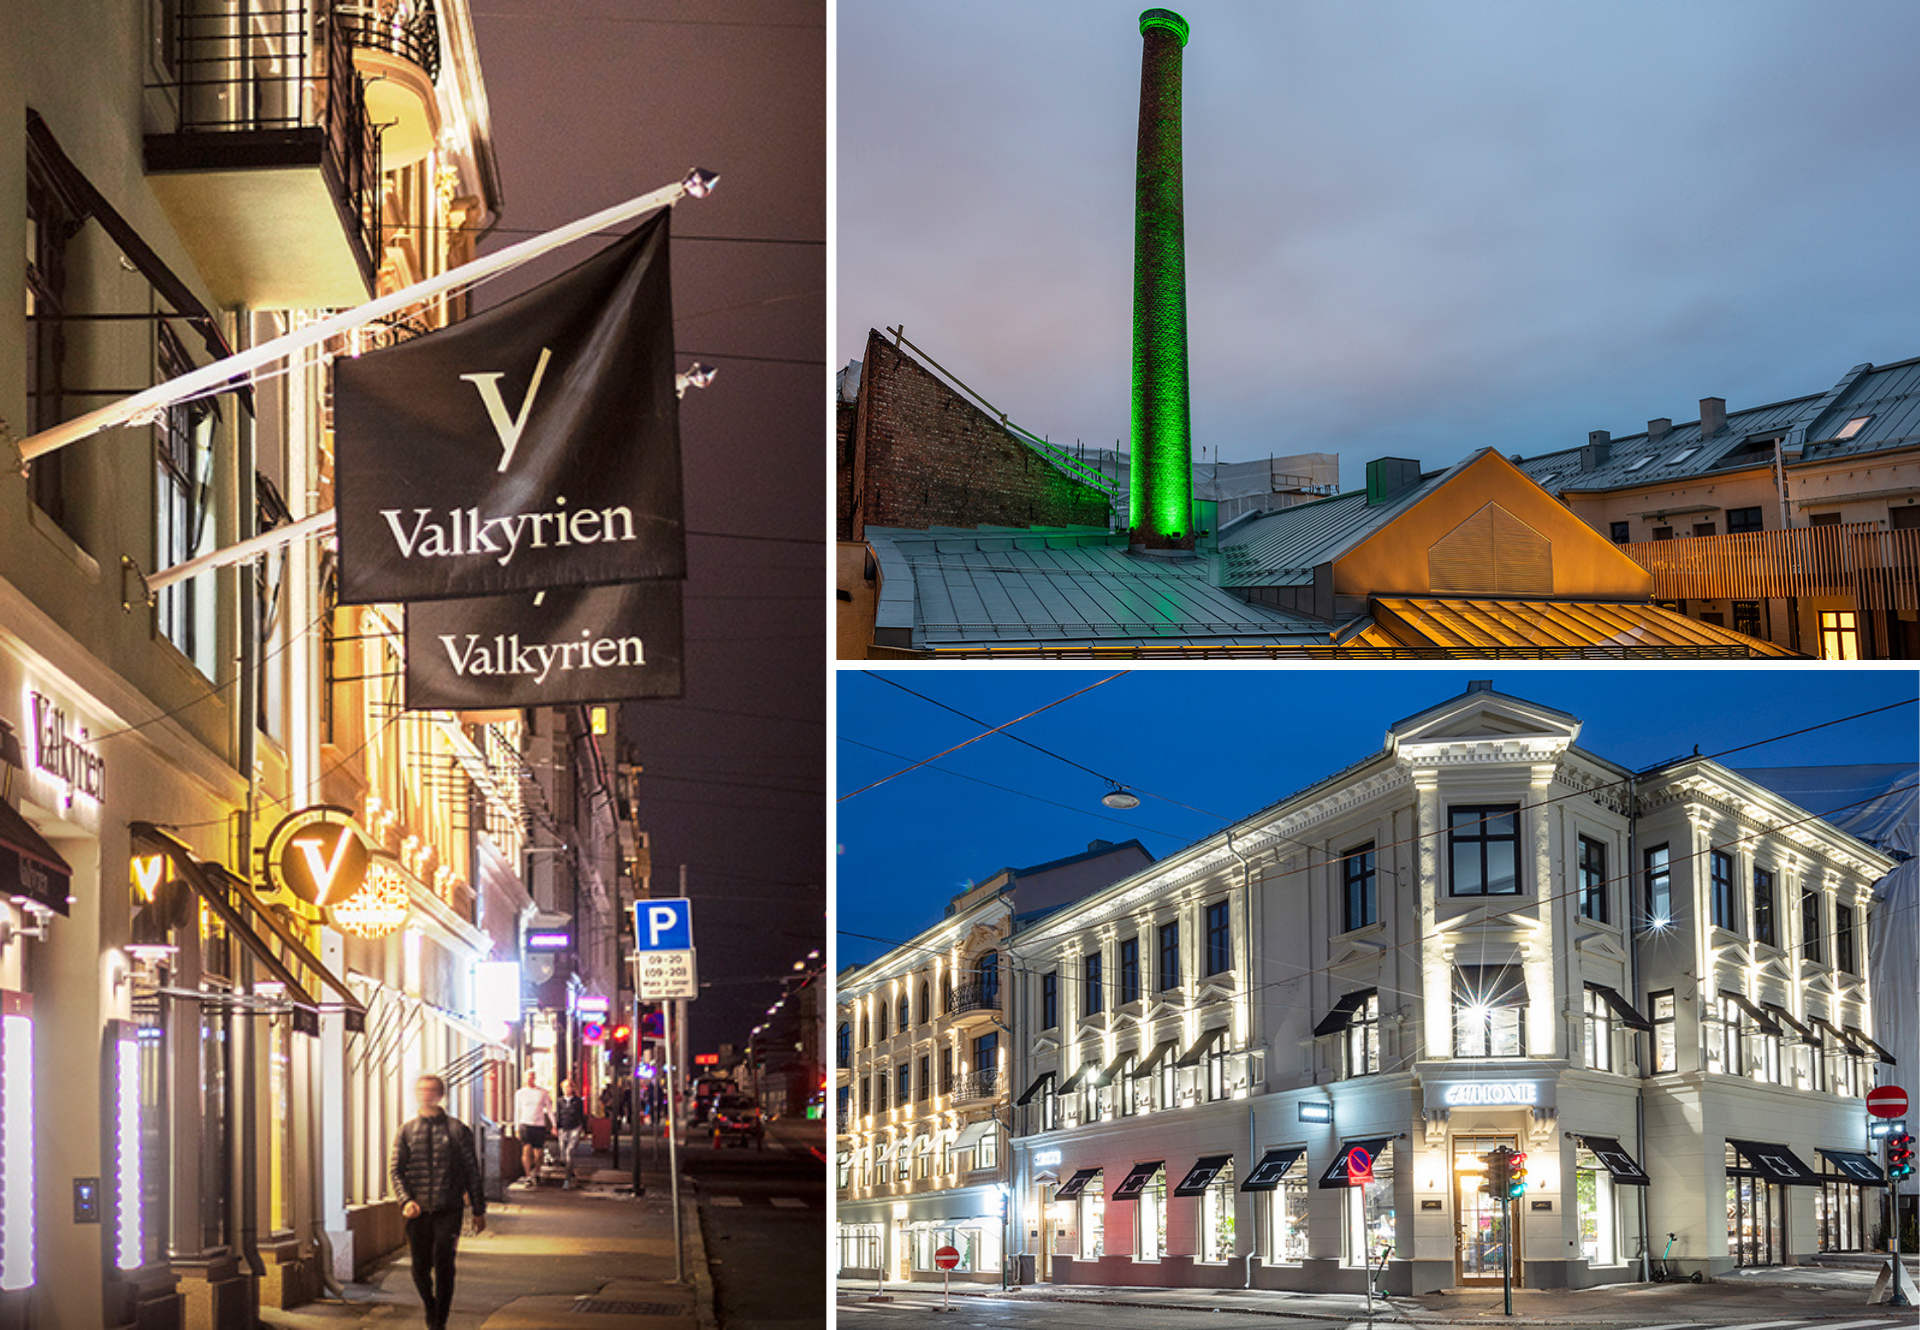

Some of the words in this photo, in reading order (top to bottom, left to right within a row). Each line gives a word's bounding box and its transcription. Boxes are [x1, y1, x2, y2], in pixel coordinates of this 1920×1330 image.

[380, 496, 637, 566] Valkyrien
[439, 629, 646, 685] Valkyrien
[30, 690, 106, 809] Valkyrien
[649, 907, 677, 946] P
